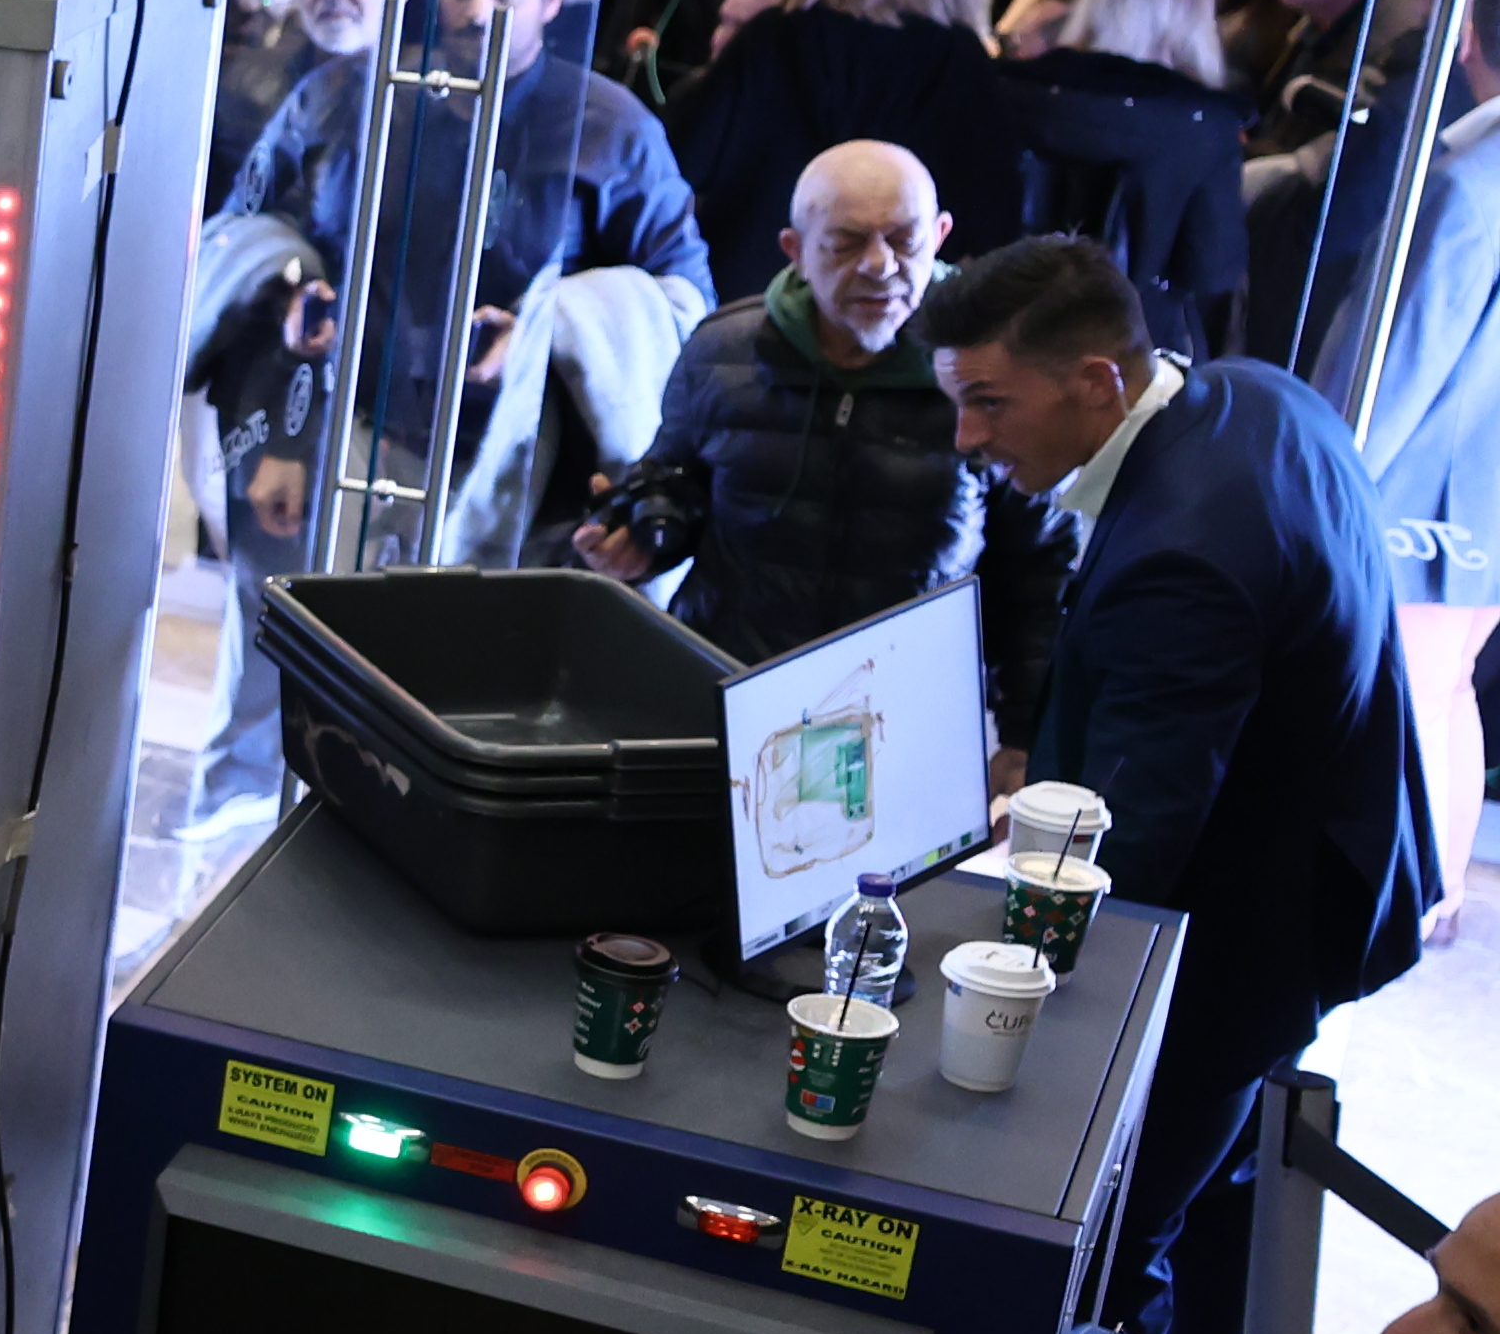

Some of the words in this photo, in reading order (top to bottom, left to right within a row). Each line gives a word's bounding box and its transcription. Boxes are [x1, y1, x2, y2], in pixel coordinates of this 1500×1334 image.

[229, 1066, 298, 1096] SYSTEM
[303, 1084, 329, 1103] ON
[237, 1094, 315, 1120] CAUTION
[798, 1197, 871, 1229] X-RAY
[878, 1217, 914, 1240] ON
[821, 1229, 903, 1256] CAUTION
